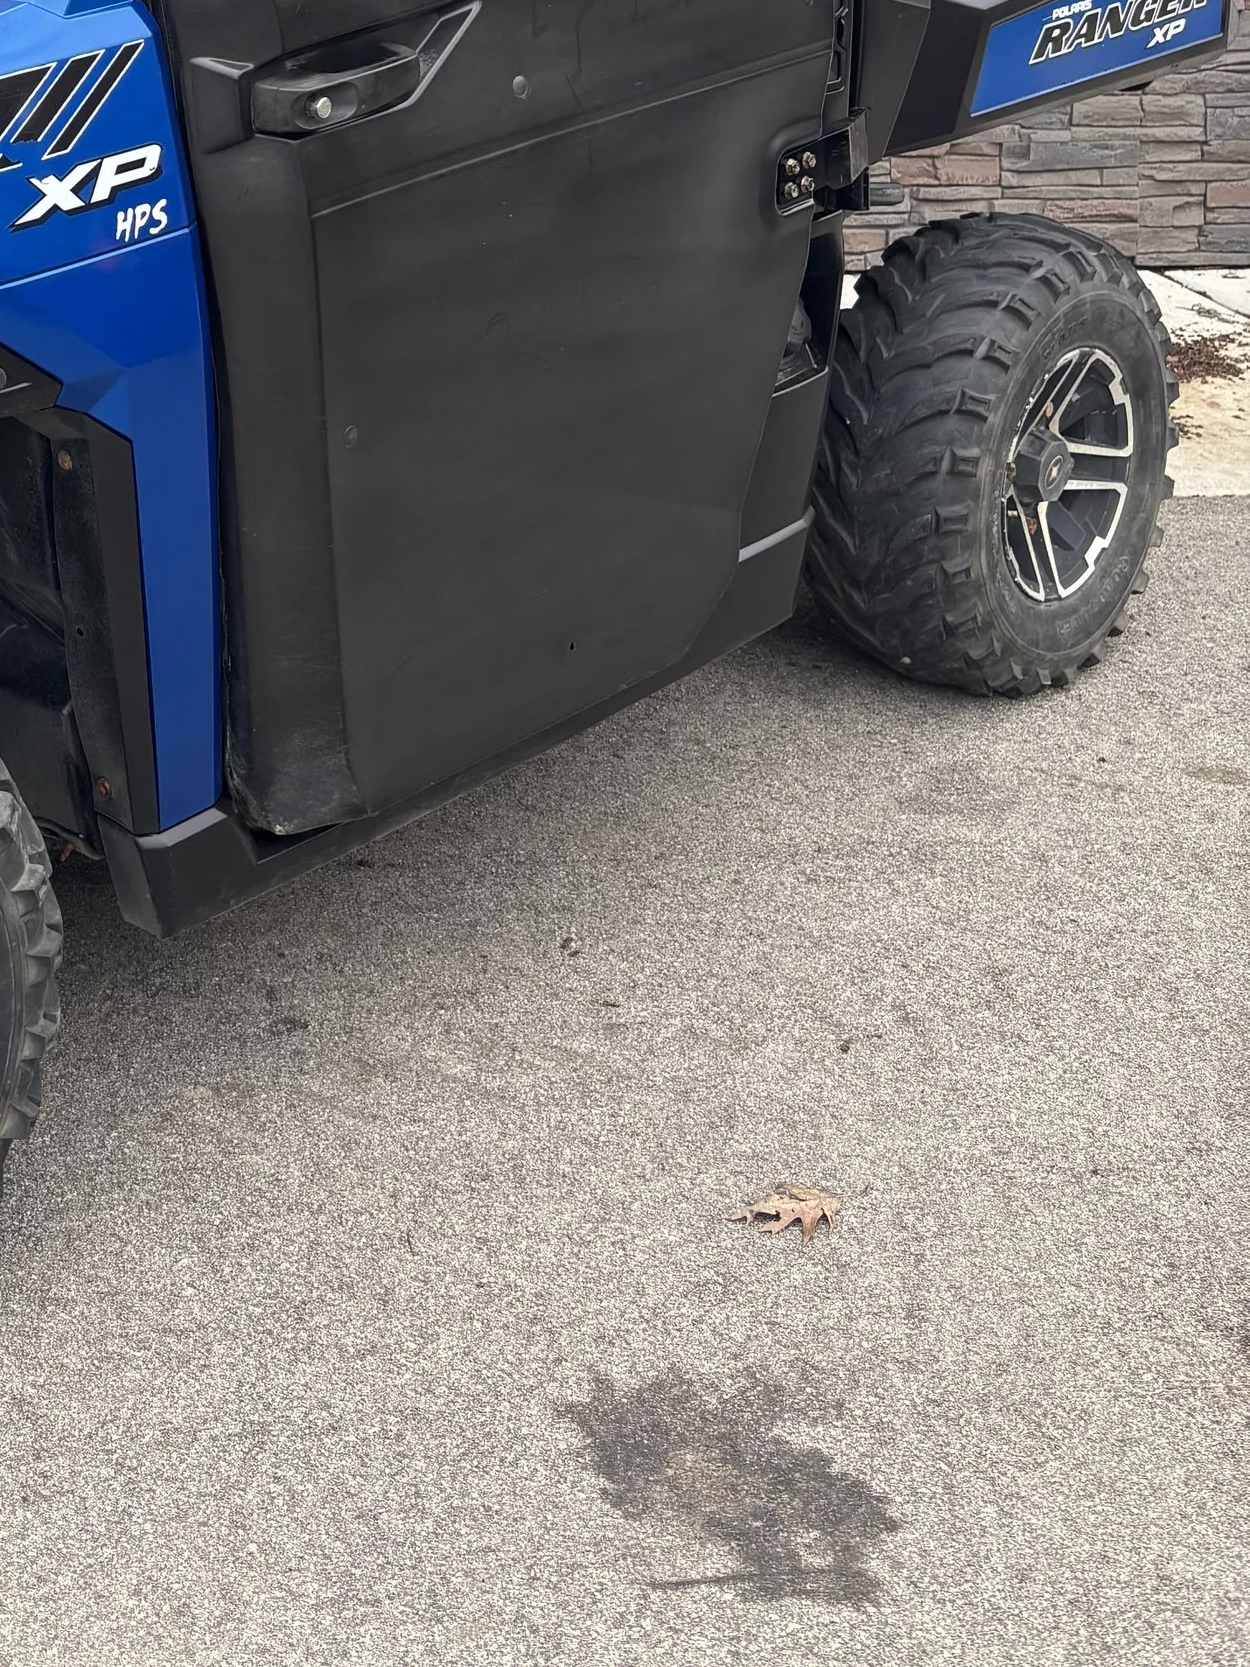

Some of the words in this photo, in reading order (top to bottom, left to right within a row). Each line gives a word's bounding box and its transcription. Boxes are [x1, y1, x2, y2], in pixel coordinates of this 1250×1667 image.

[1145, 18, 1186, 49] XP
[8, 143, 163, 231] XP
[115, 198, 168, 242] HPS
